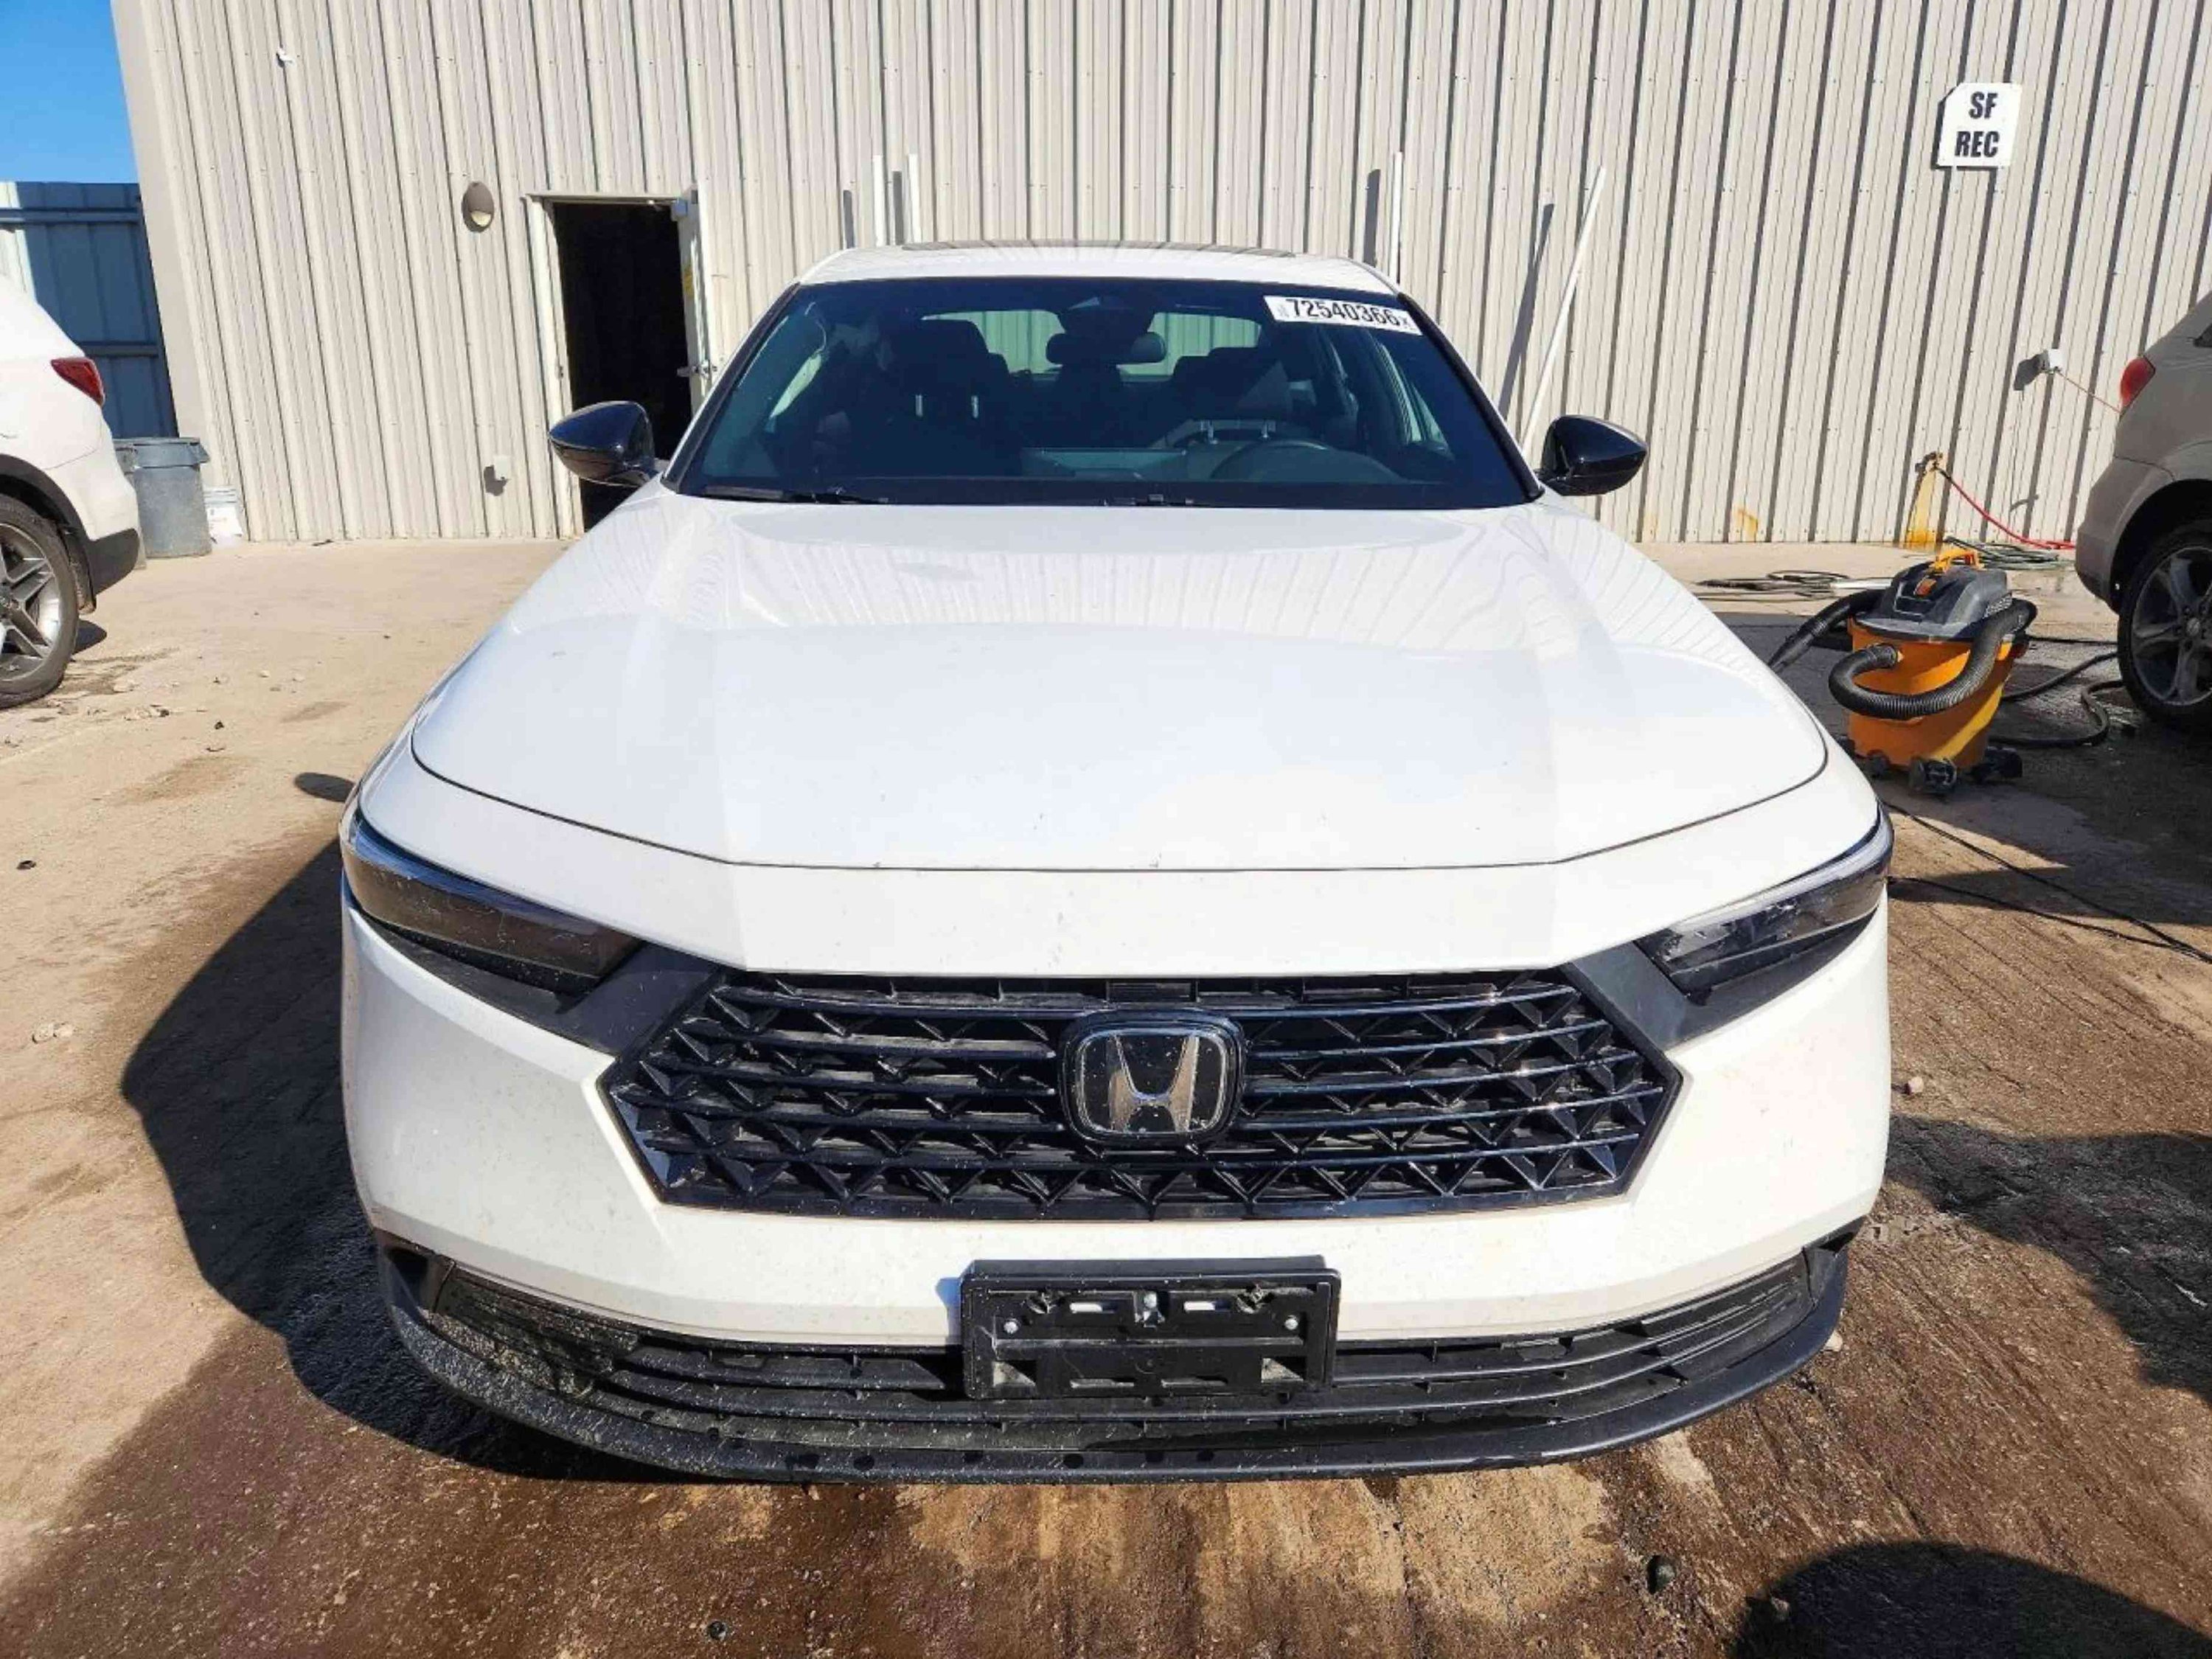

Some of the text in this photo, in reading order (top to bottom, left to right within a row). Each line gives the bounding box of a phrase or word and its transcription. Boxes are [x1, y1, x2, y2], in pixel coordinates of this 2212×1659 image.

[1968, 91, 1998, 119] SF
[1955, 131, 2000, 158] REC
[1286, 298, 1400, 326] 72540366
